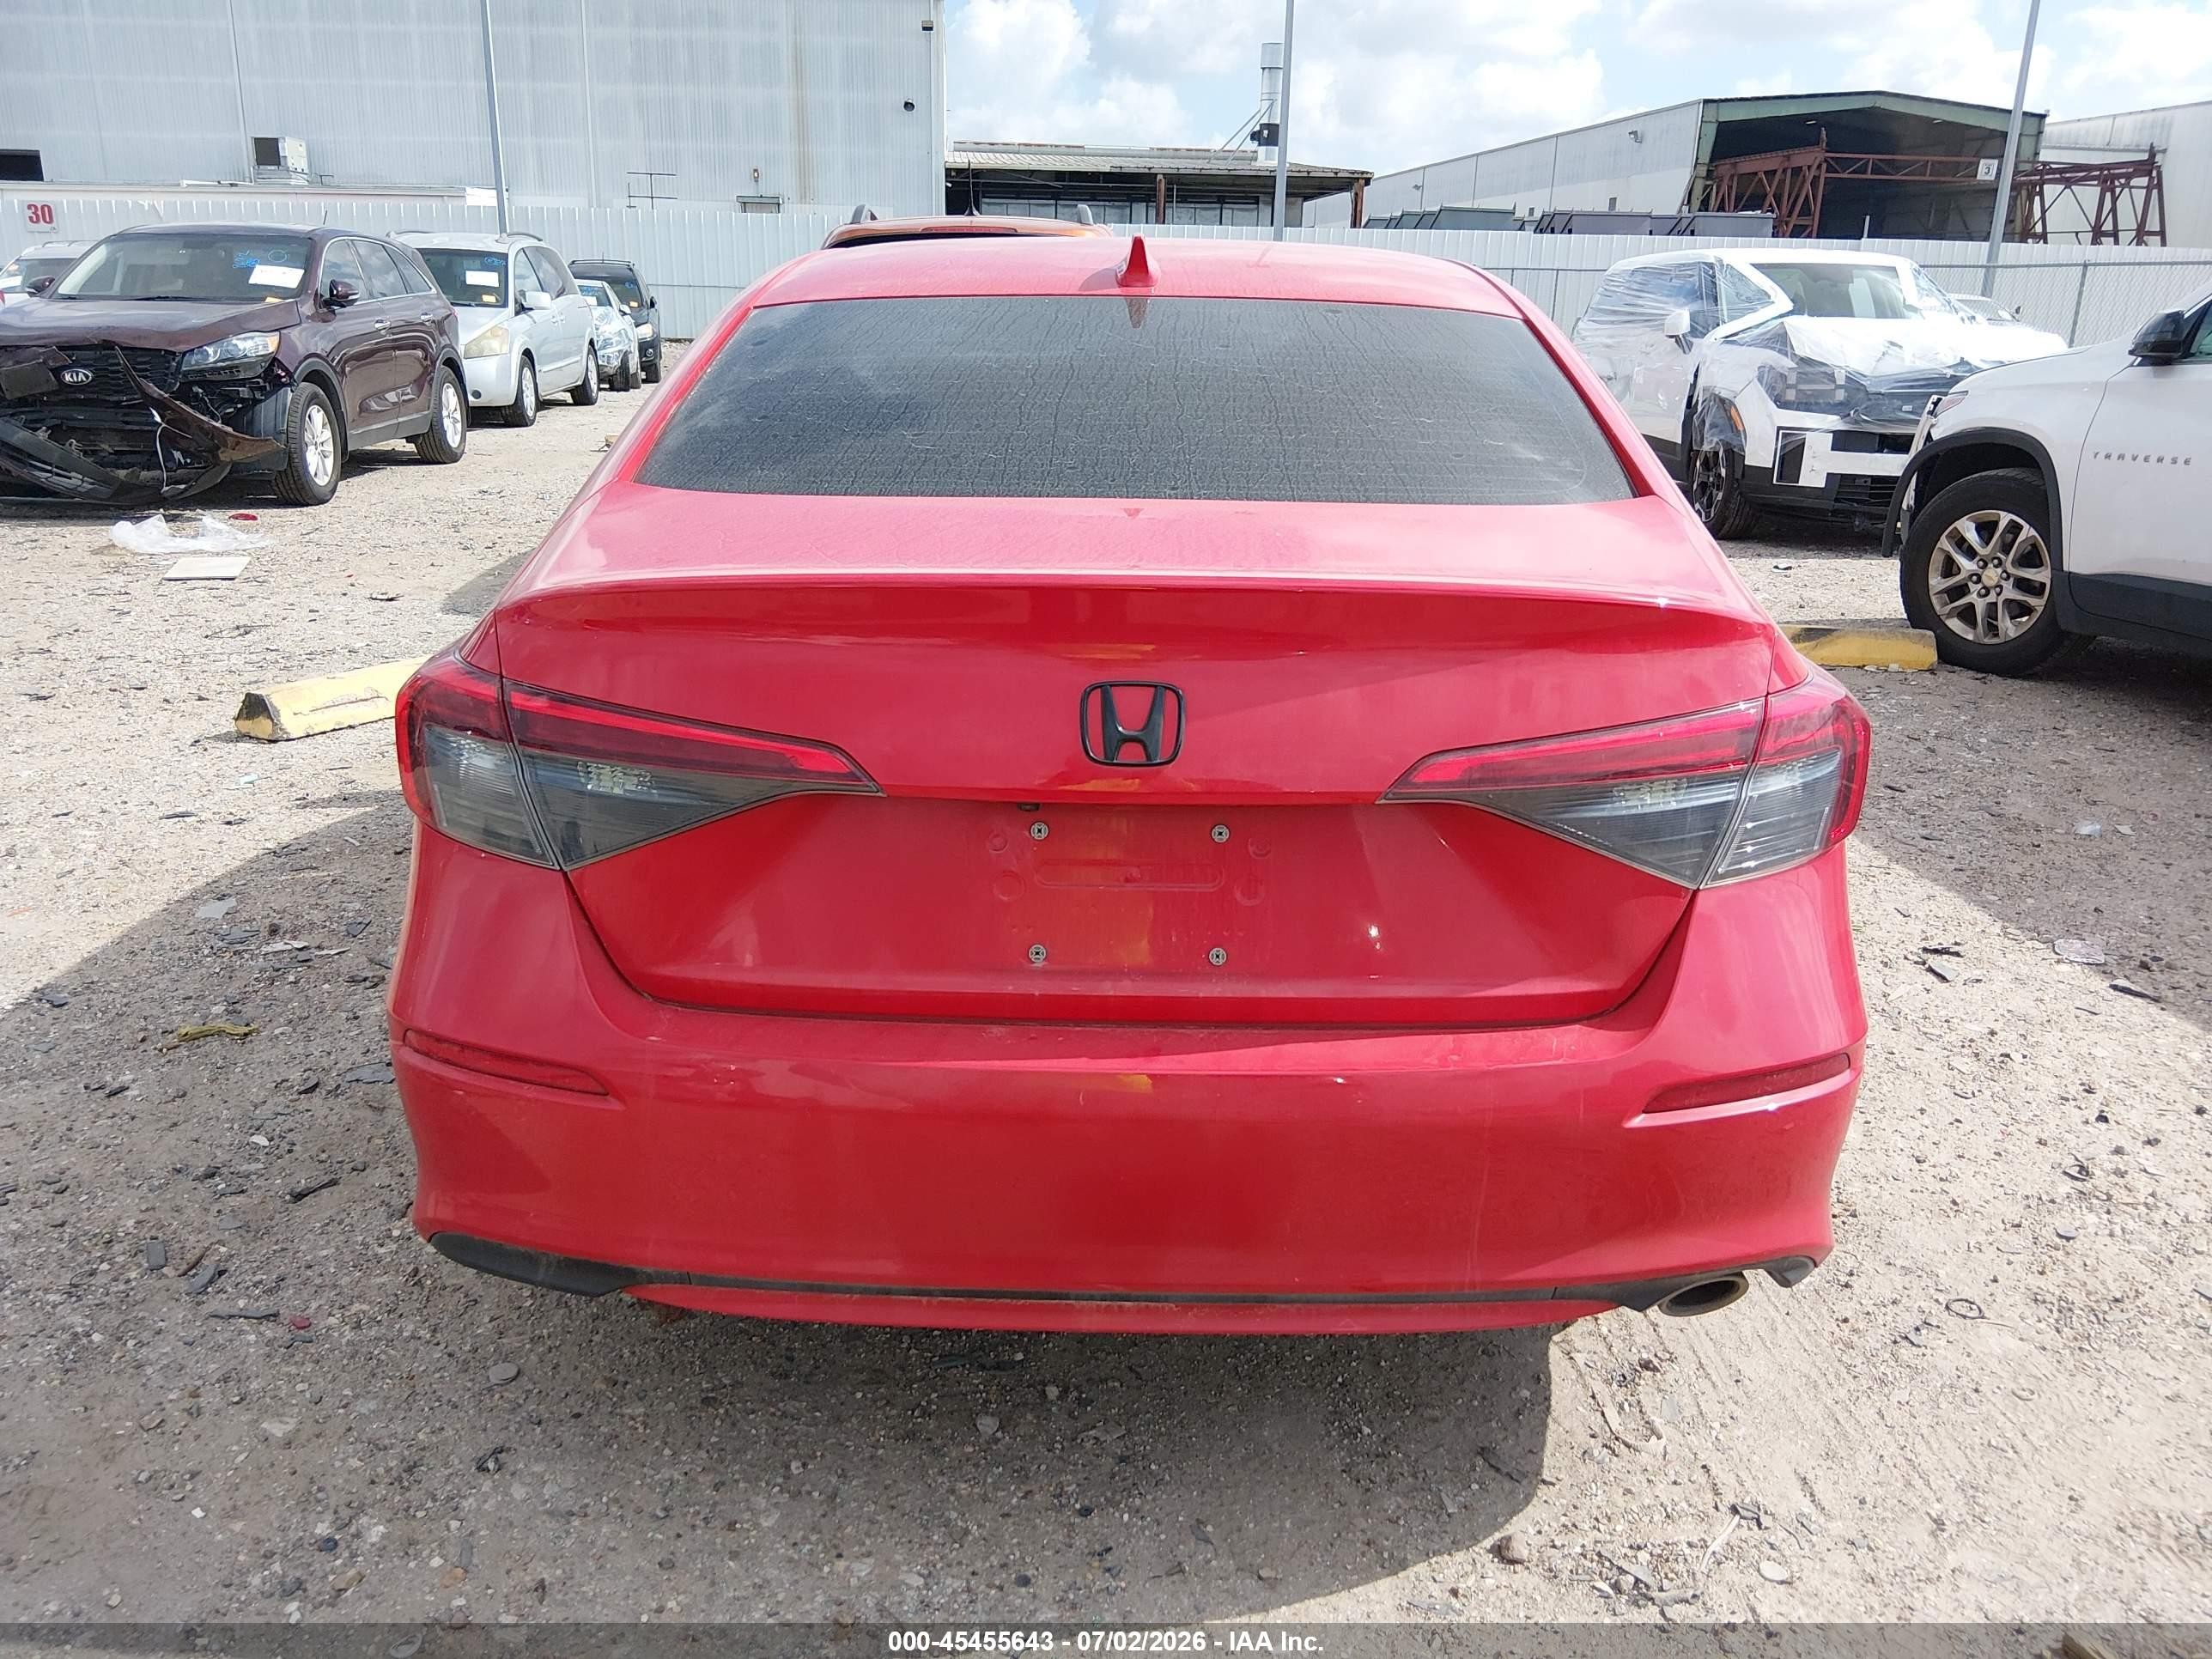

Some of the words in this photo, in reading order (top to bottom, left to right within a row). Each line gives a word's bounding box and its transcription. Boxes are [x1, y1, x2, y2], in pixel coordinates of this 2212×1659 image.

[27, 204, 54, 224] 30
[64, 372, 87, 382] KIA
[2094, 451, 2192, 465] TRAVERSE
